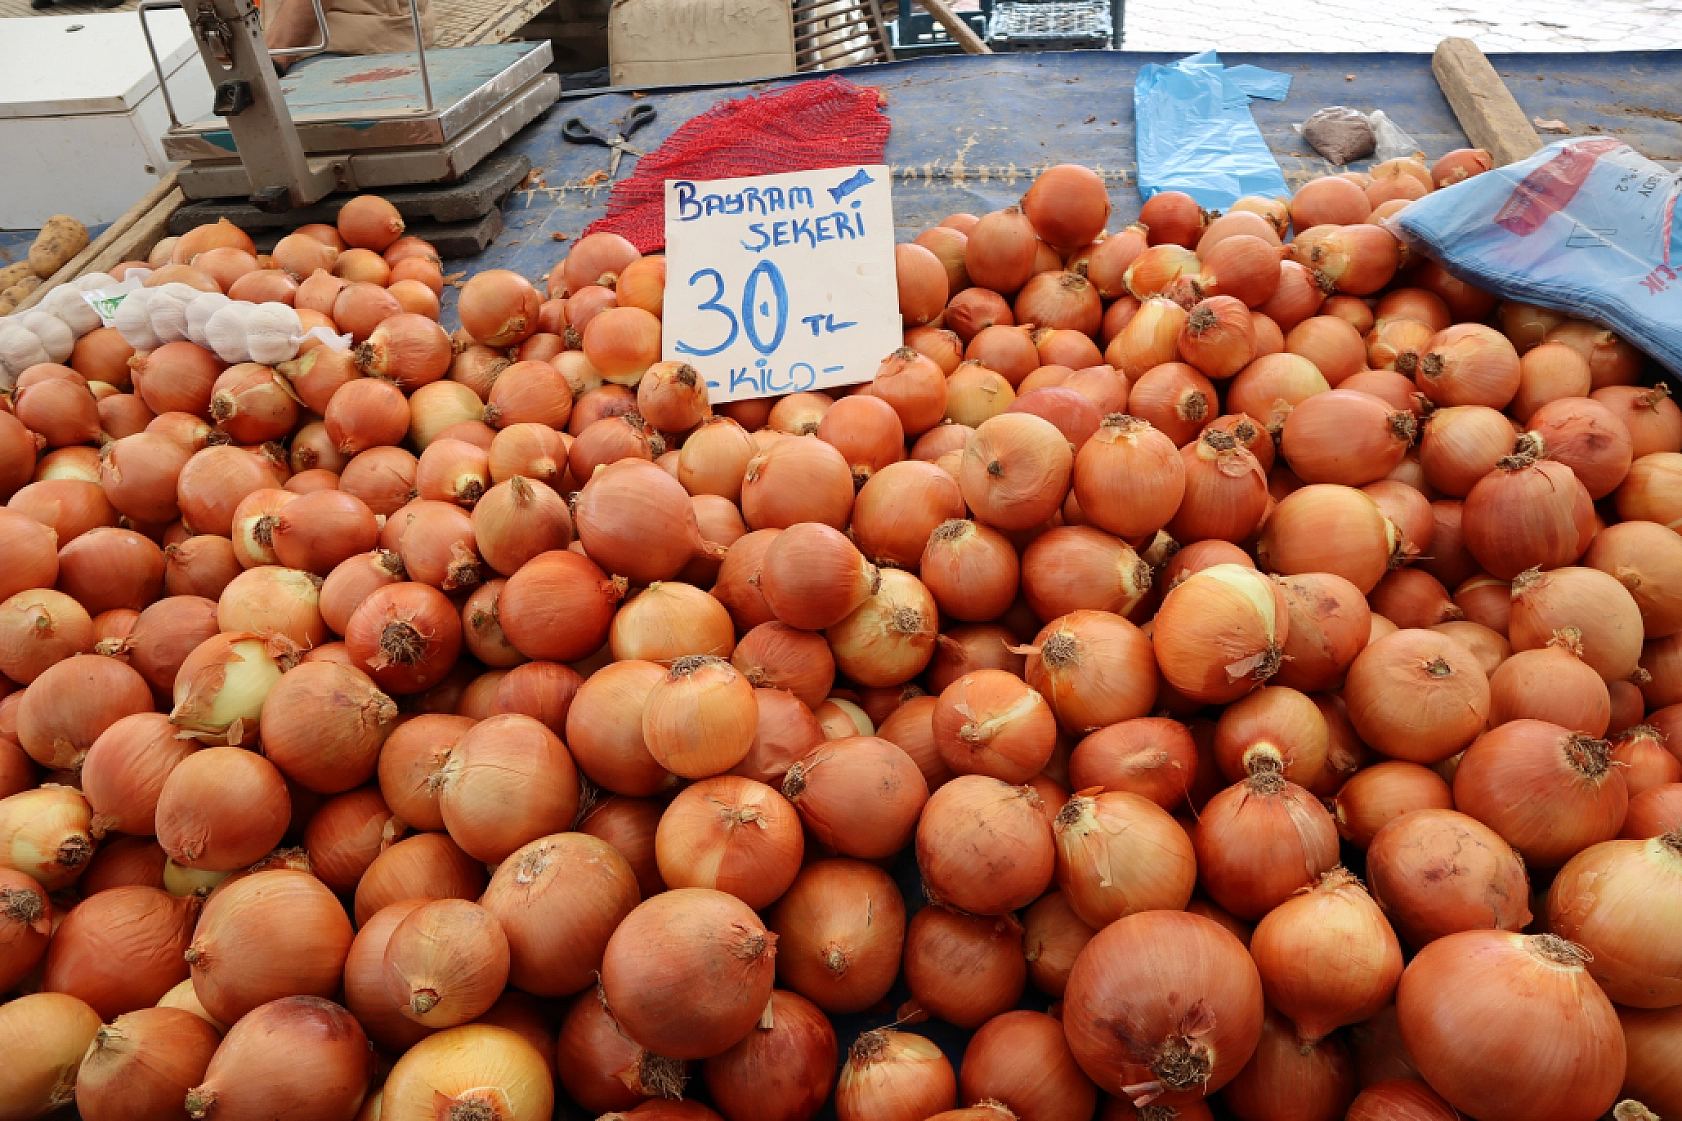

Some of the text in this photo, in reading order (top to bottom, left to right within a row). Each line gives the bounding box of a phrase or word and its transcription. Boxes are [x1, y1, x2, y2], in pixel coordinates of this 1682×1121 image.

[673, 181, 815, 221] BAYRAM
[675, 259, 859, 357] 30 TL
